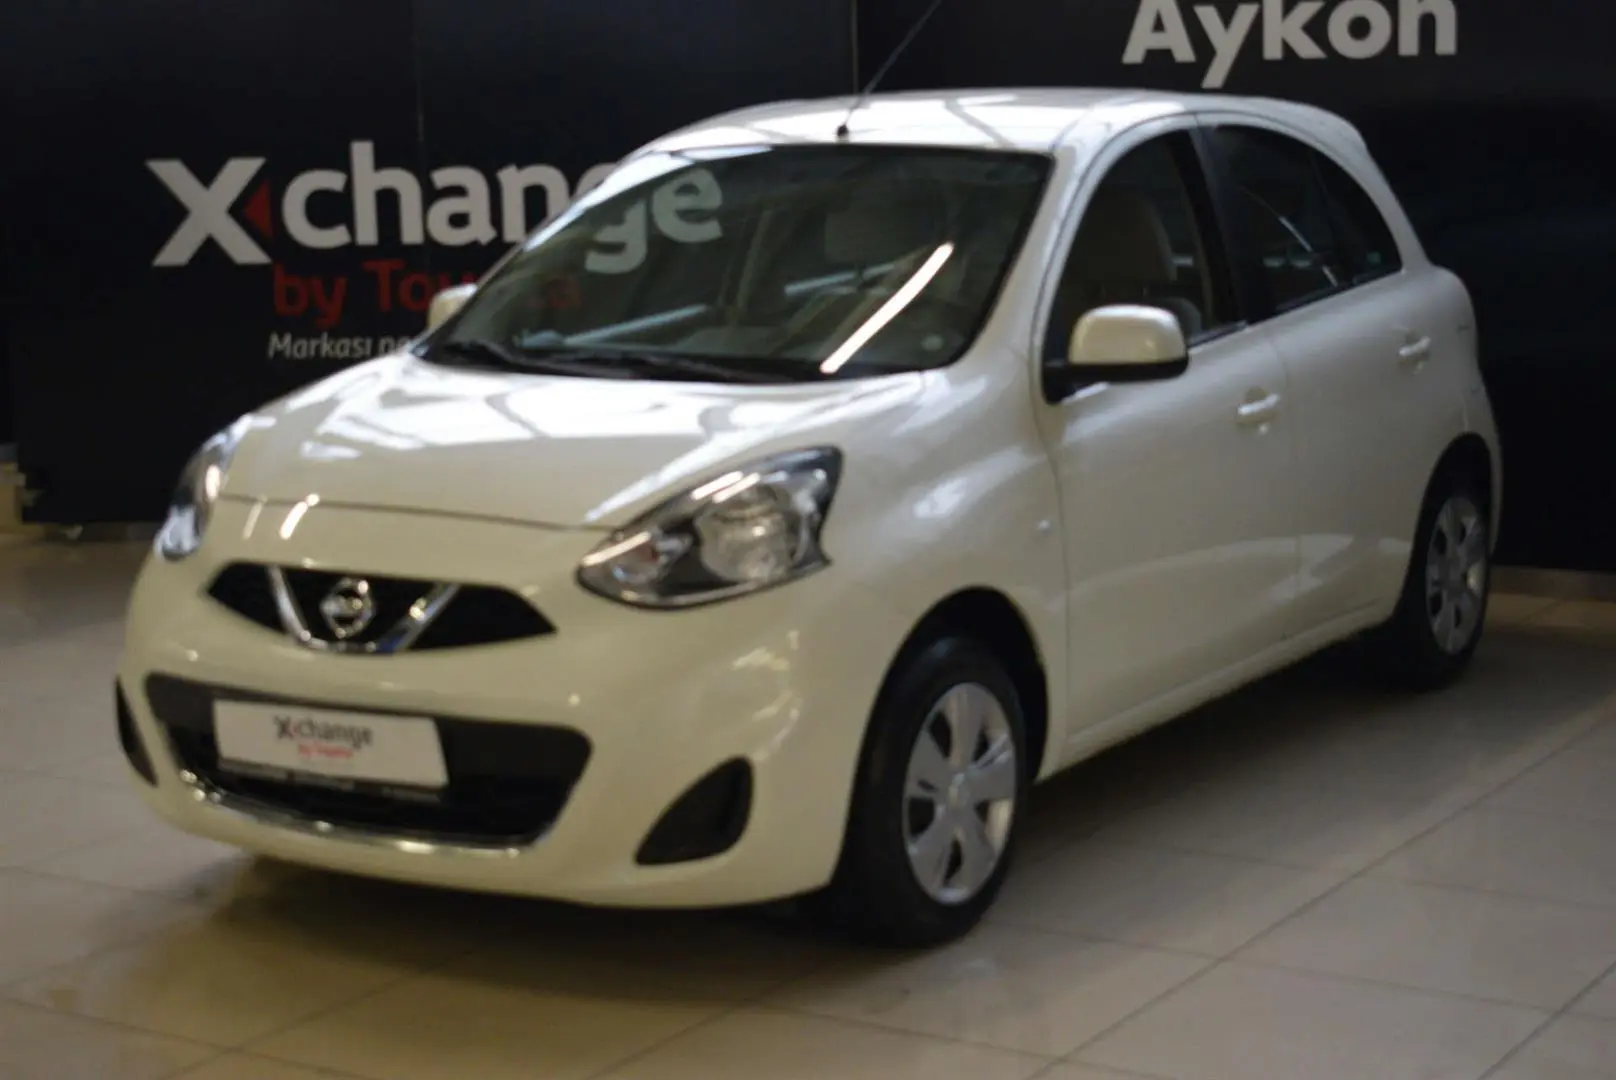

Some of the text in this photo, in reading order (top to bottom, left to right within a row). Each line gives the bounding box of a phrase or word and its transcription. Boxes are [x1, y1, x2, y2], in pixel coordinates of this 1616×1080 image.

[1122, 0, 1457, 89] Aykon
[272, 261, 347, 328] by
[267, 332, 372, 360] Markası
